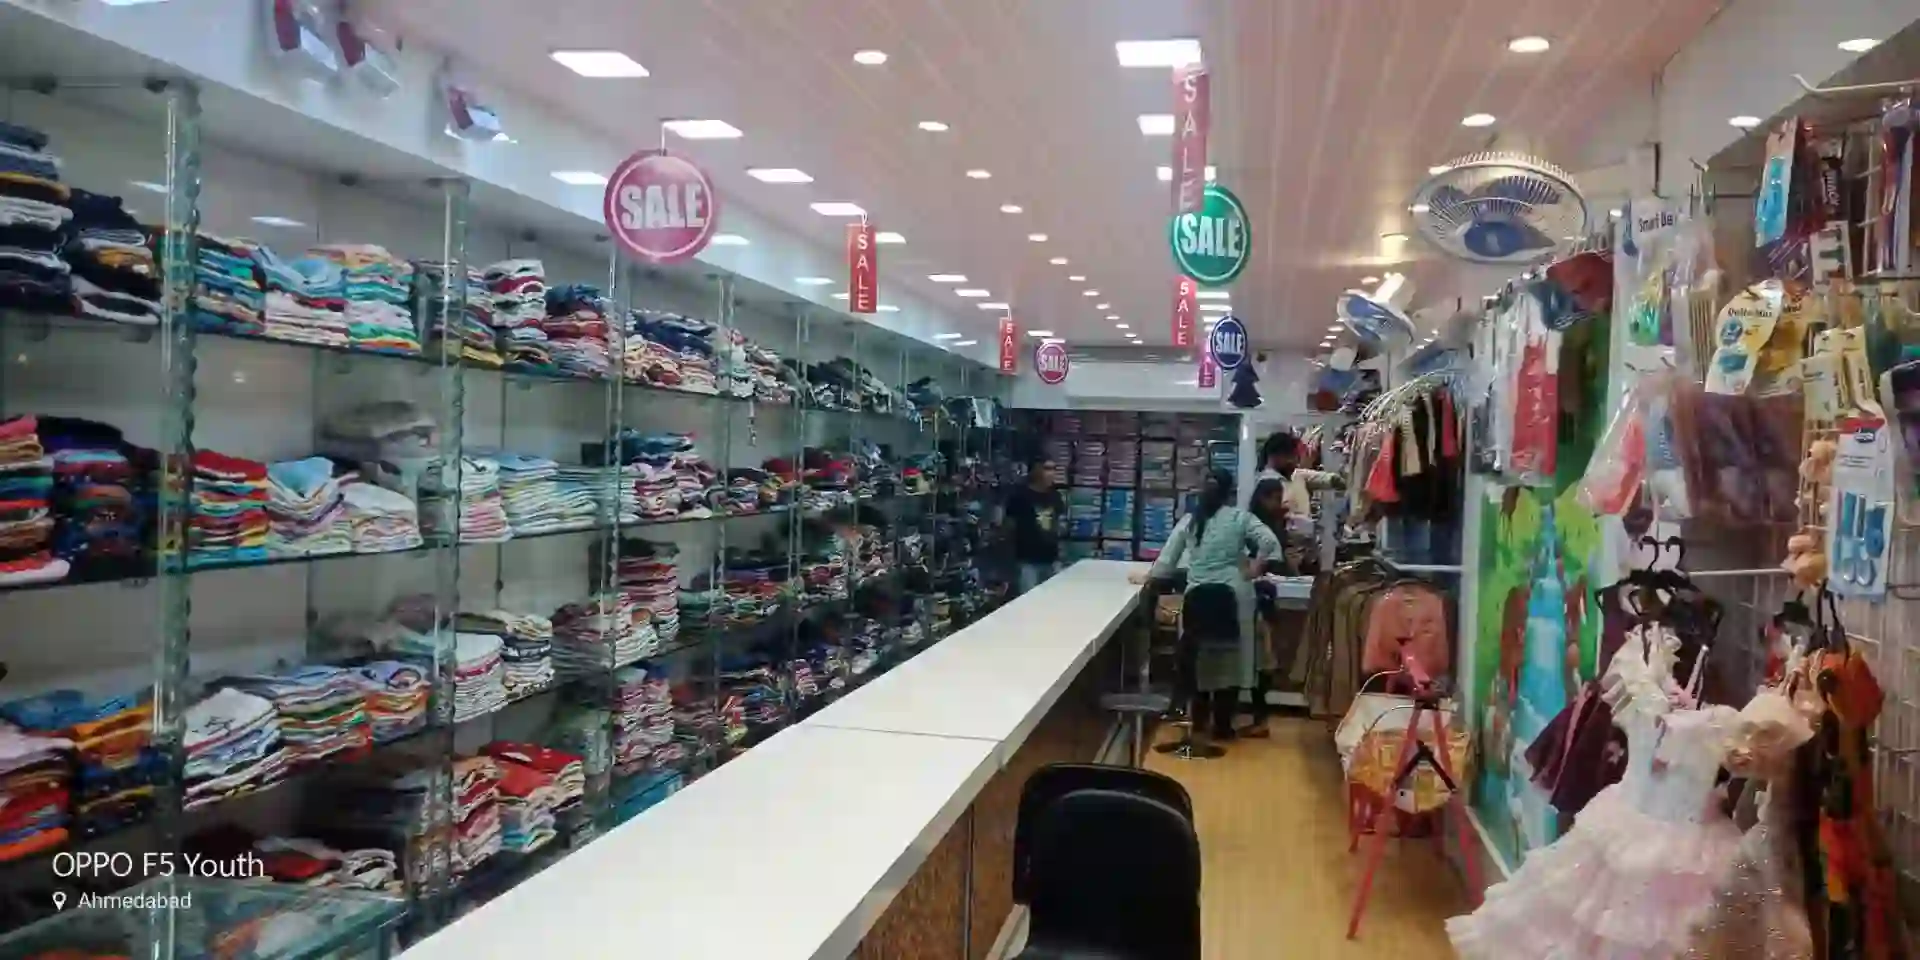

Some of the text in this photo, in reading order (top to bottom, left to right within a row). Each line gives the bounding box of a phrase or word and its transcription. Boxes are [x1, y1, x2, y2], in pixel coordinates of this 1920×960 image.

[1178, 74, 1198, 212] SALE
[619, 183, 706, 230] SALE
[1179, 212, 1241, 258] SALE
[856, 234, 870, 310] SALE
[1177, 281, 1189, 346] SALE
[1003, 322, 1013, 371] SALE
[1039, 353, 1067, 372] SALE
[1214, 331, 1244, 354] SALE
